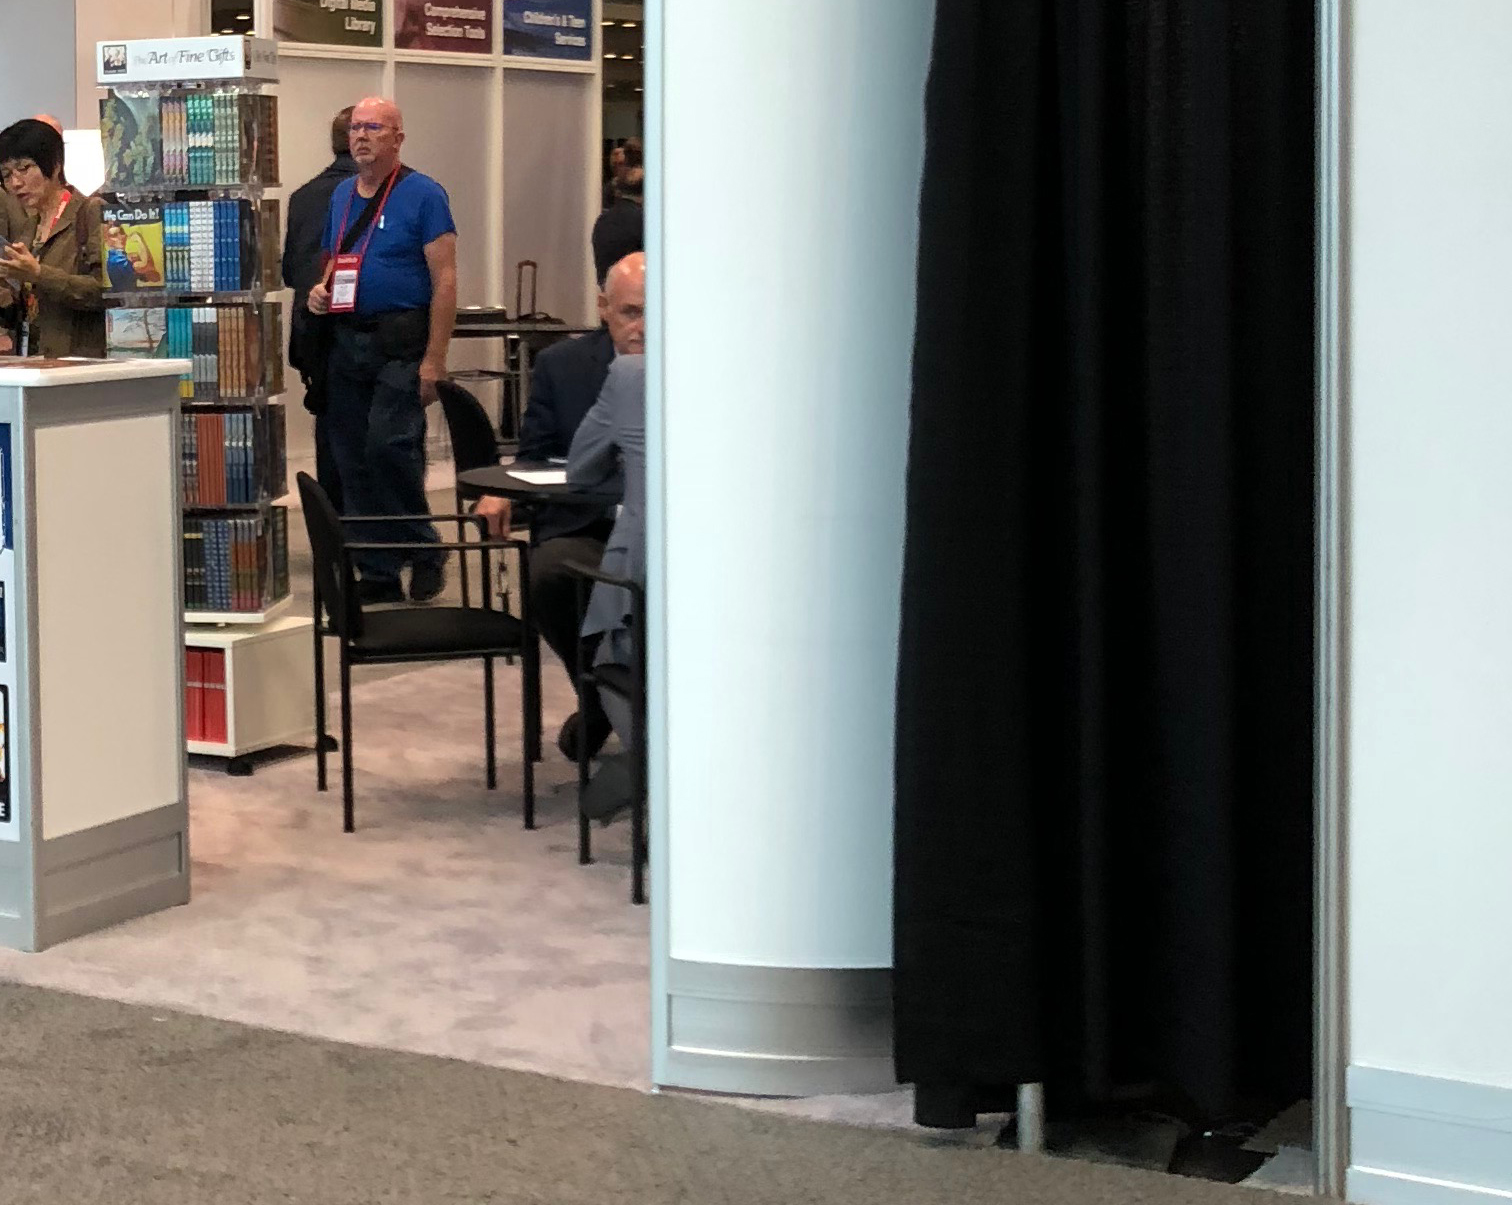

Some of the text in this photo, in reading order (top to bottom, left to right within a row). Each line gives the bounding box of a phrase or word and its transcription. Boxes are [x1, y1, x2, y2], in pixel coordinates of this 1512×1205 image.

[148, 51, 169, 65] Art
[178, 49, 205, 64] Fine
[207, 47, 236, 66] Gifts
[117, 209, 135, 221] Can
[134, 208, 148, 221] Do
